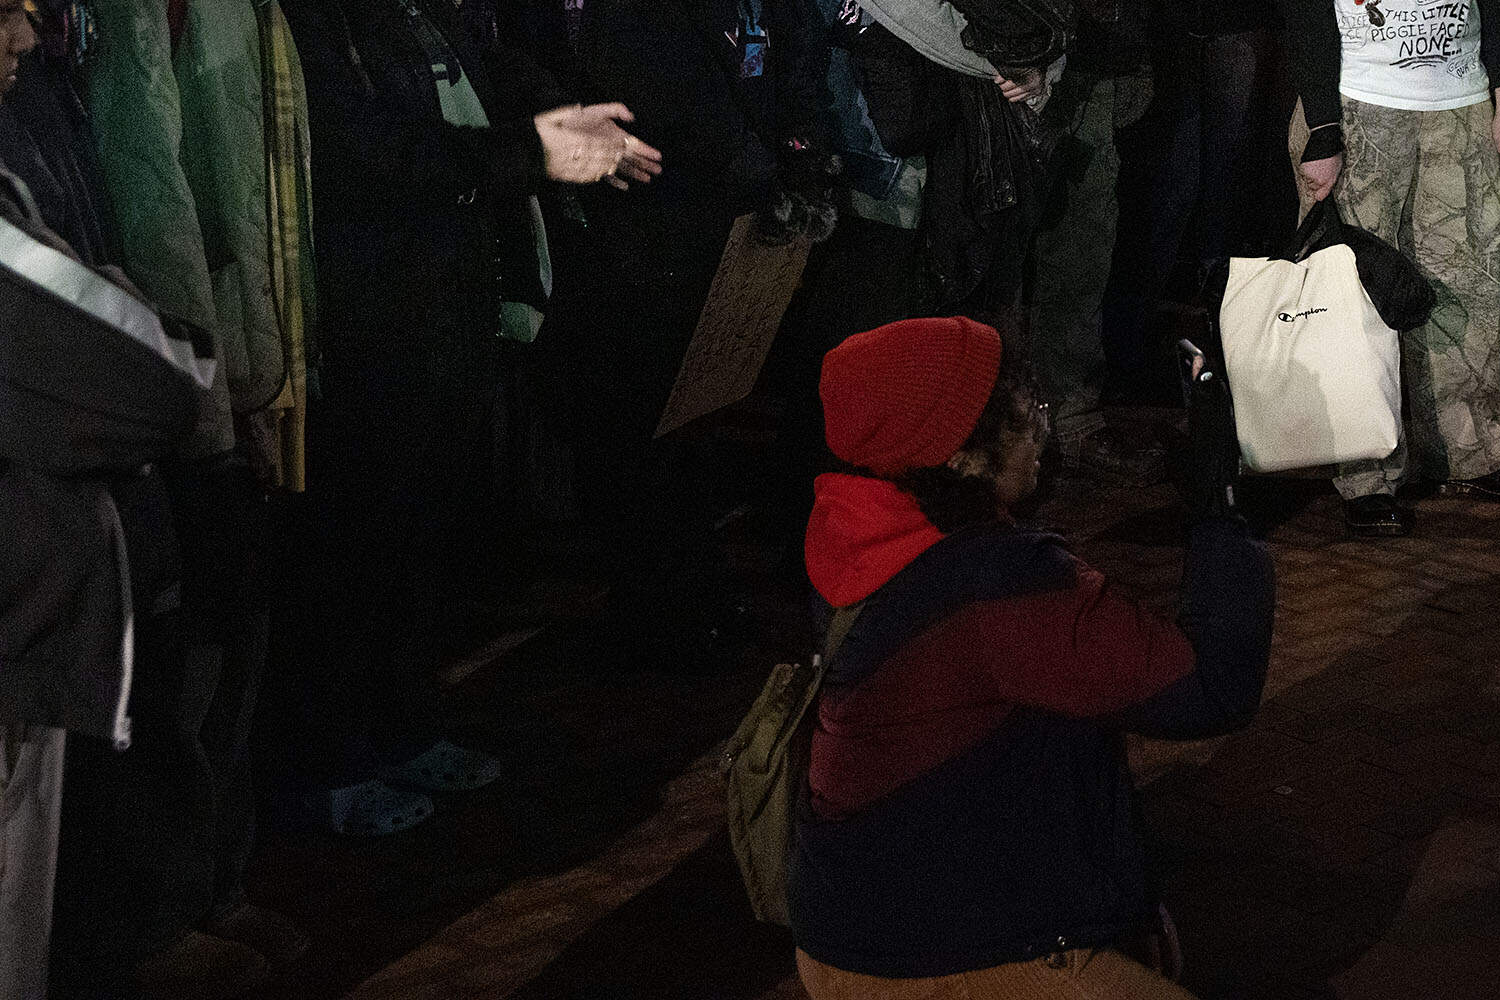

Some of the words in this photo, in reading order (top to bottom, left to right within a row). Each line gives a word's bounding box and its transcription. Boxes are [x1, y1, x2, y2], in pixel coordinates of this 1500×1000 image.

[1385, 7, 1418, 22] THIS
[1421, 2, 1470, 21] LITTLE
[1371, 23, 1427, 42] PIGGIE
